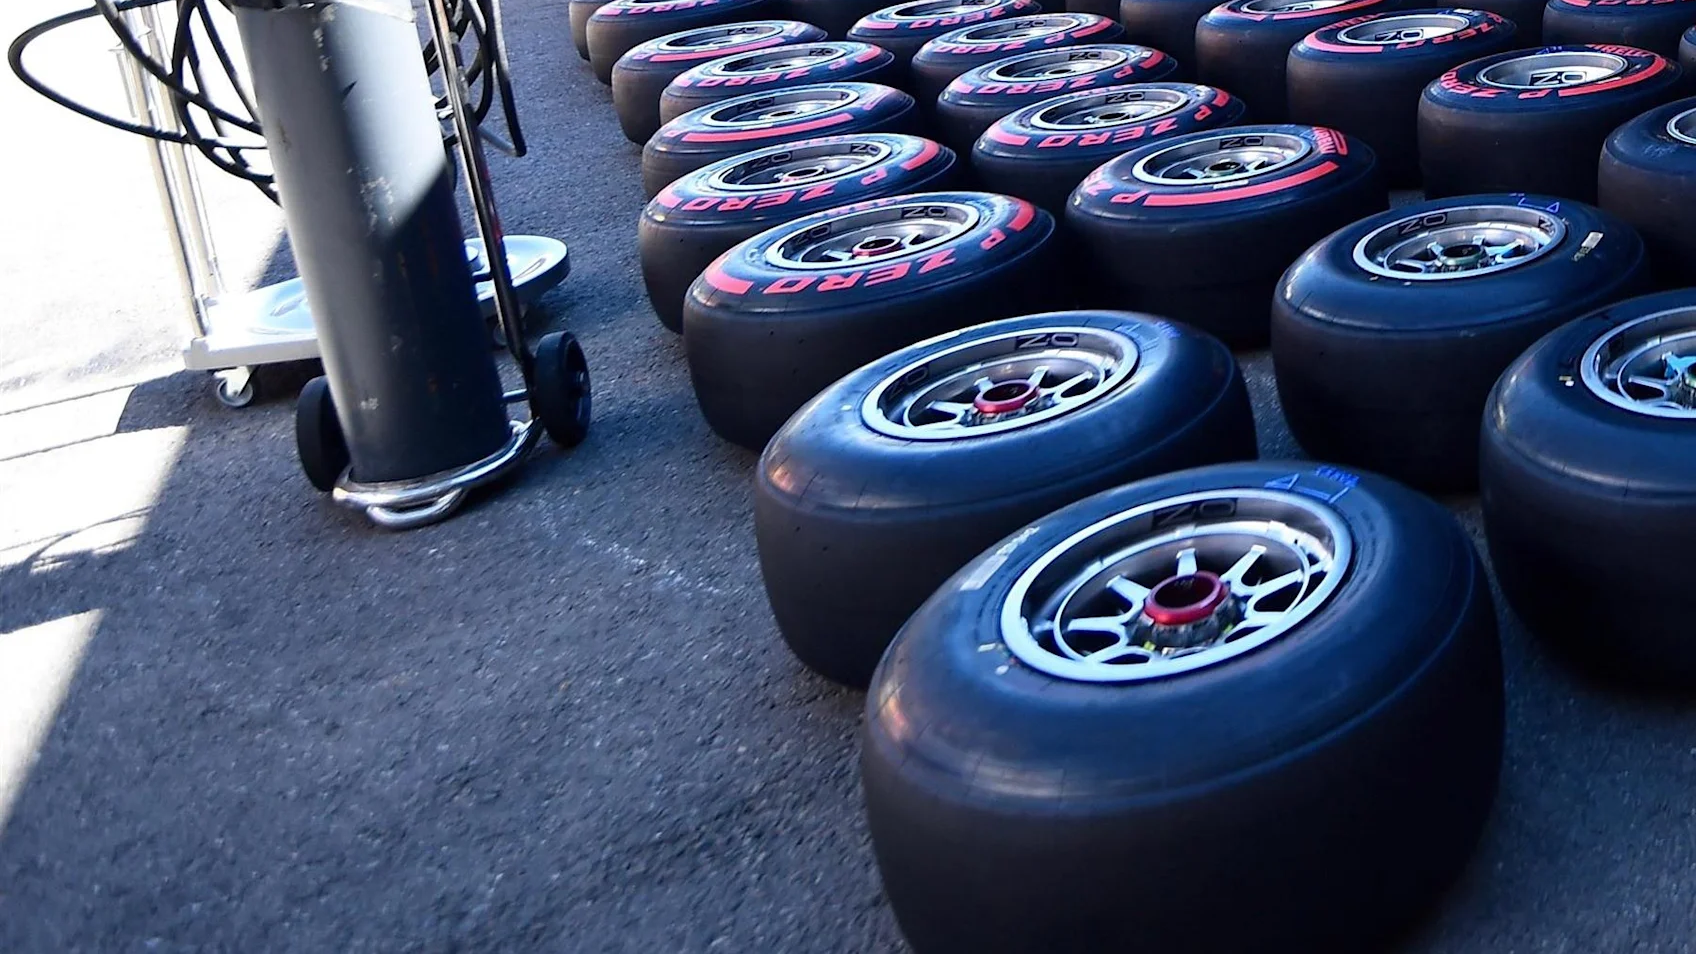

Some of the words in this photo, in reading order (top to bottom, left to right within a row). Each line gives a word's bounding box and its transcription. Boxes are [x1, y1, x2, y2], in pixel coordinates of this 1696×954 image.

[697, 69, 810, 88] ZERO
[977, 75, 1097, 94] ZERO
[1194, 105, 1213, 122] P
[1036, 117, 1179, 148] ZERO
[861, 167, 888, 186] P
[682, 182, 839, 212] ZERO
[980, 227, 1008, 252] P
[763, 248, 956, 295] ZERO
